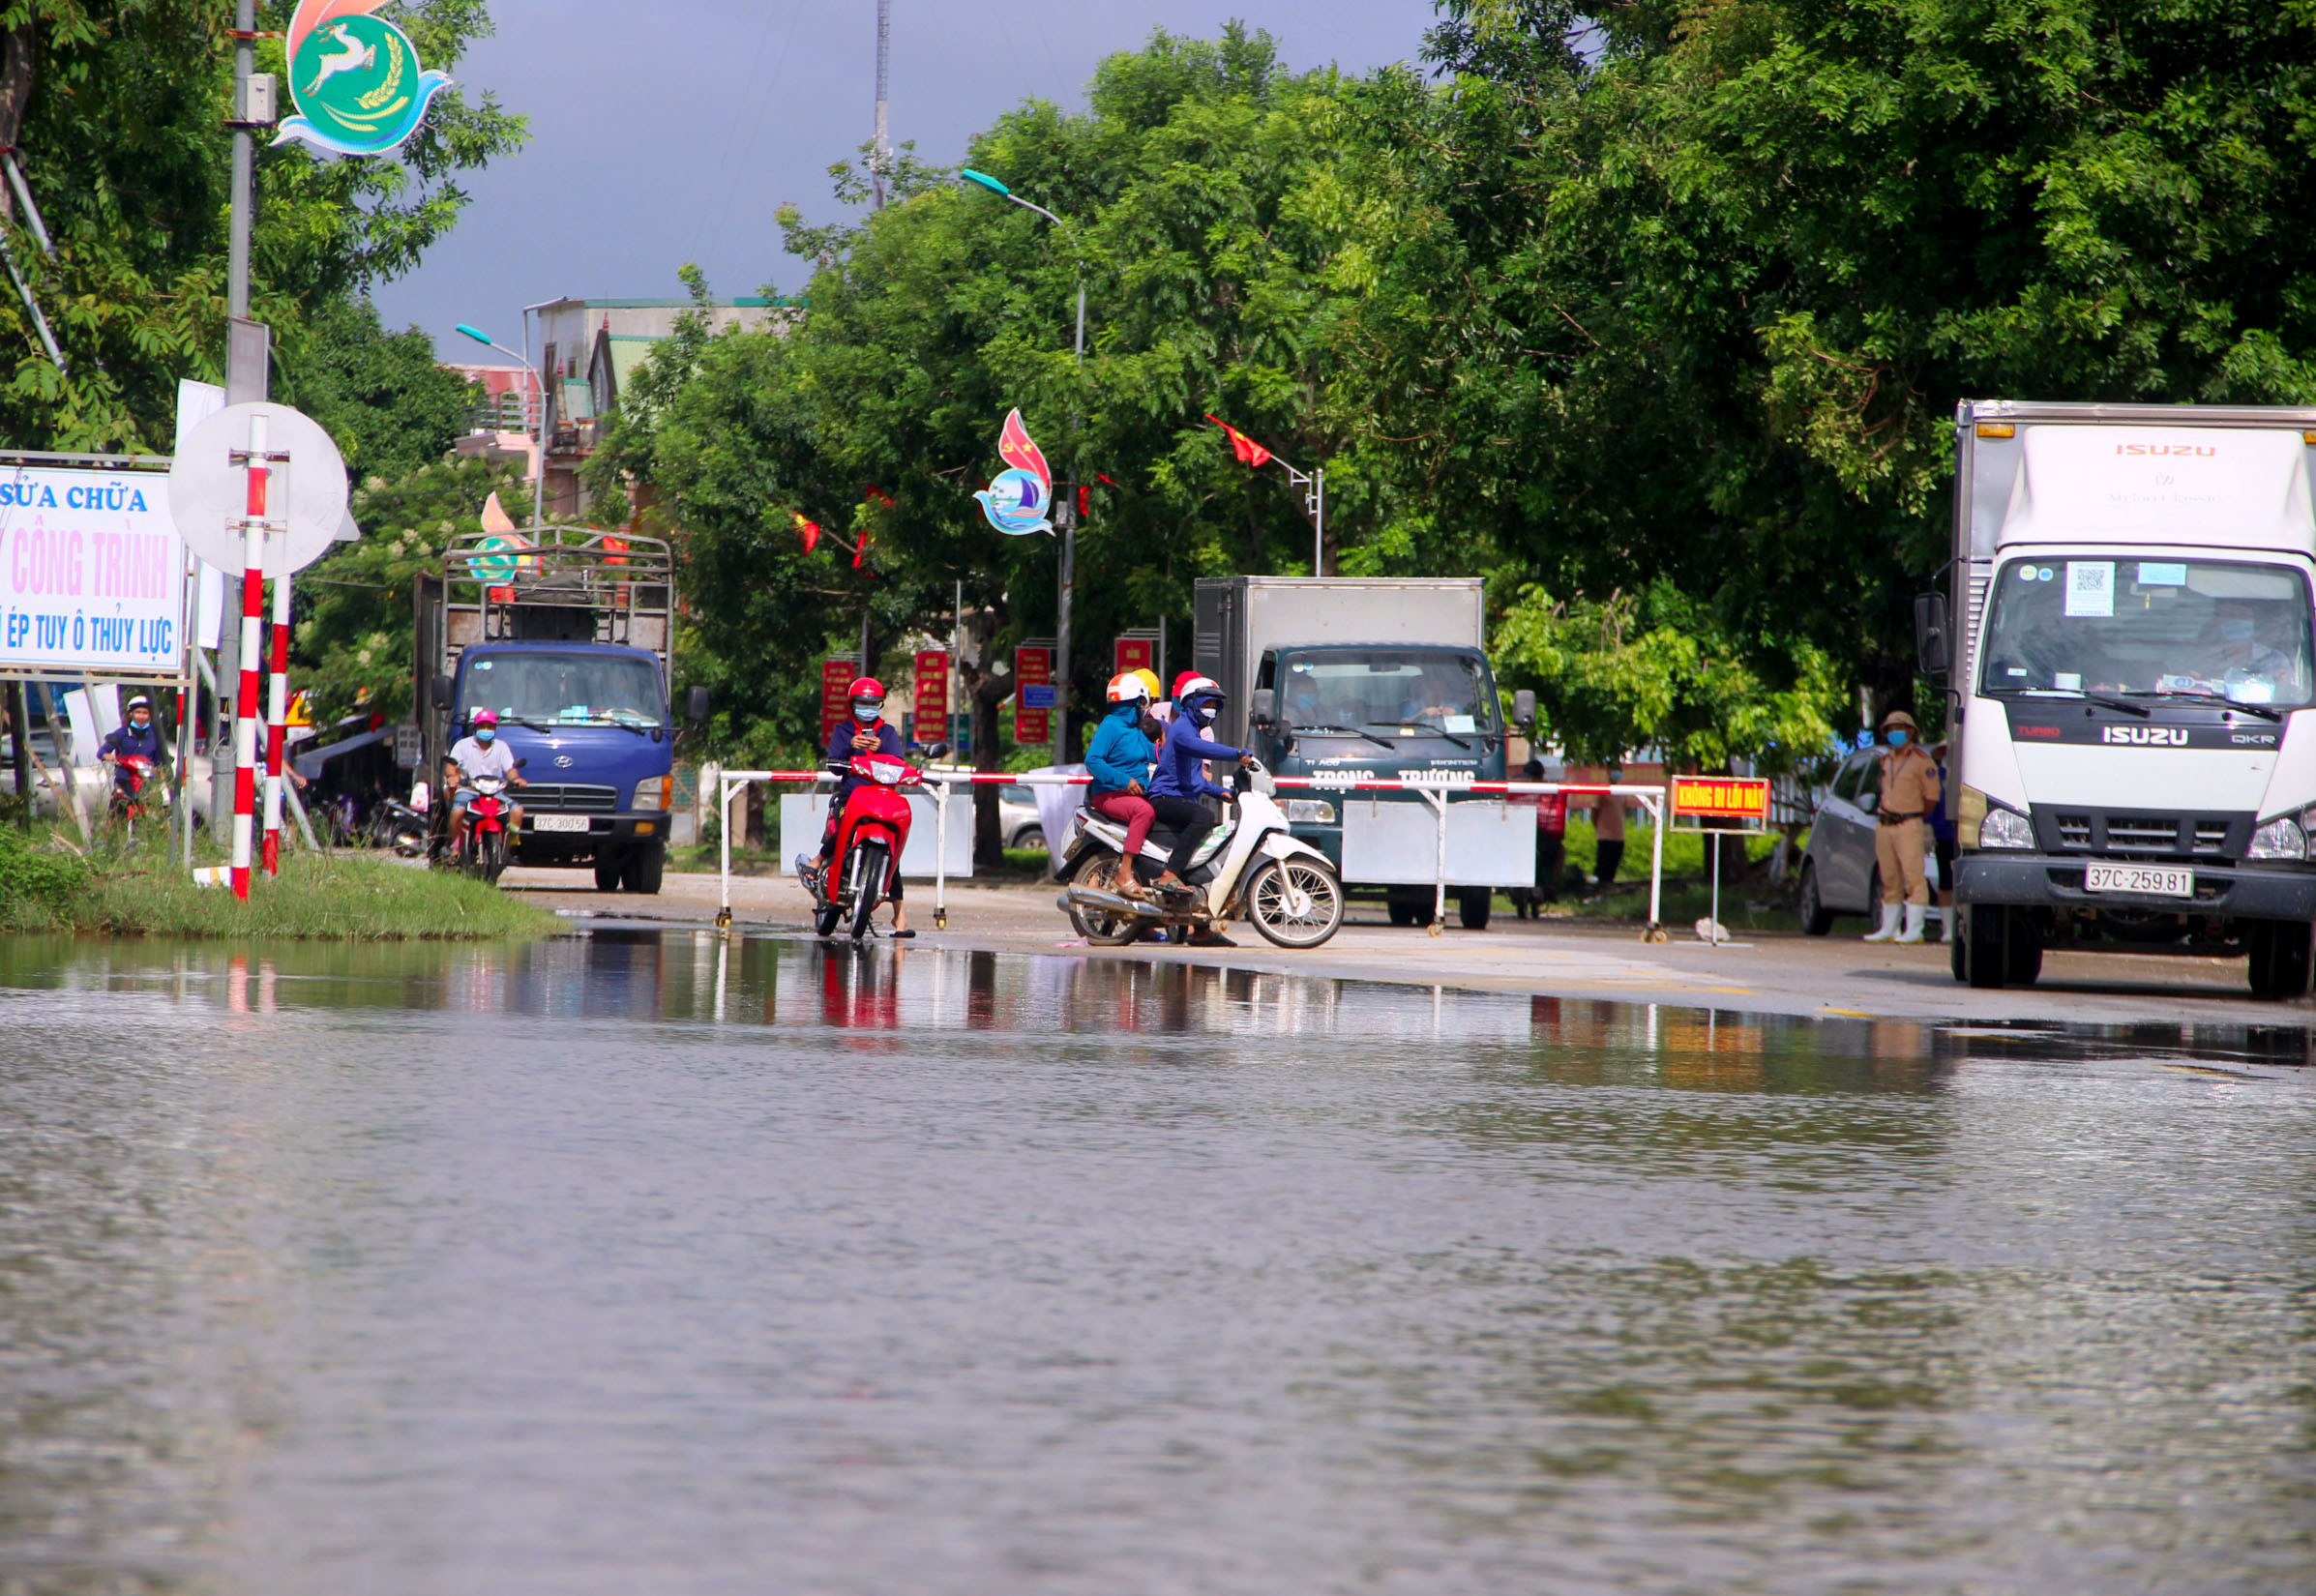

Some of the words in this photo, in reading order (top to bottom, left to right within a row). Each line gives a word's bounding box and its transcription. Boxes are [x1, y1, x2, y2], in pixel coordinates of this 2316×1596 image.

[2116, 444, 2216, 458] ISUZU
[0, 475, 58, 508] SỬA
[67, 482, 148, 513] CHỮA
[12, 515, 83, 597] CÔNG
[92, 518, 169, 600] TRÌNH
[7, 606, 30, 648] ÉP
[36, 614, 68, 650] TUY
[73, 608, 84, 651] Ô
[90, 602, 134, 653] THỦY
[138, 616, 172, 662] LỰC
[2017, 725, 2062, 738] TURBO
[2103, 726, 2189, 746] ISUZU
[2231, 734, 2275, 745] QKR
[1678, 782, 1712, 808] KHÔNG
[2090, 869, 2187, 893] 37C-259.81
